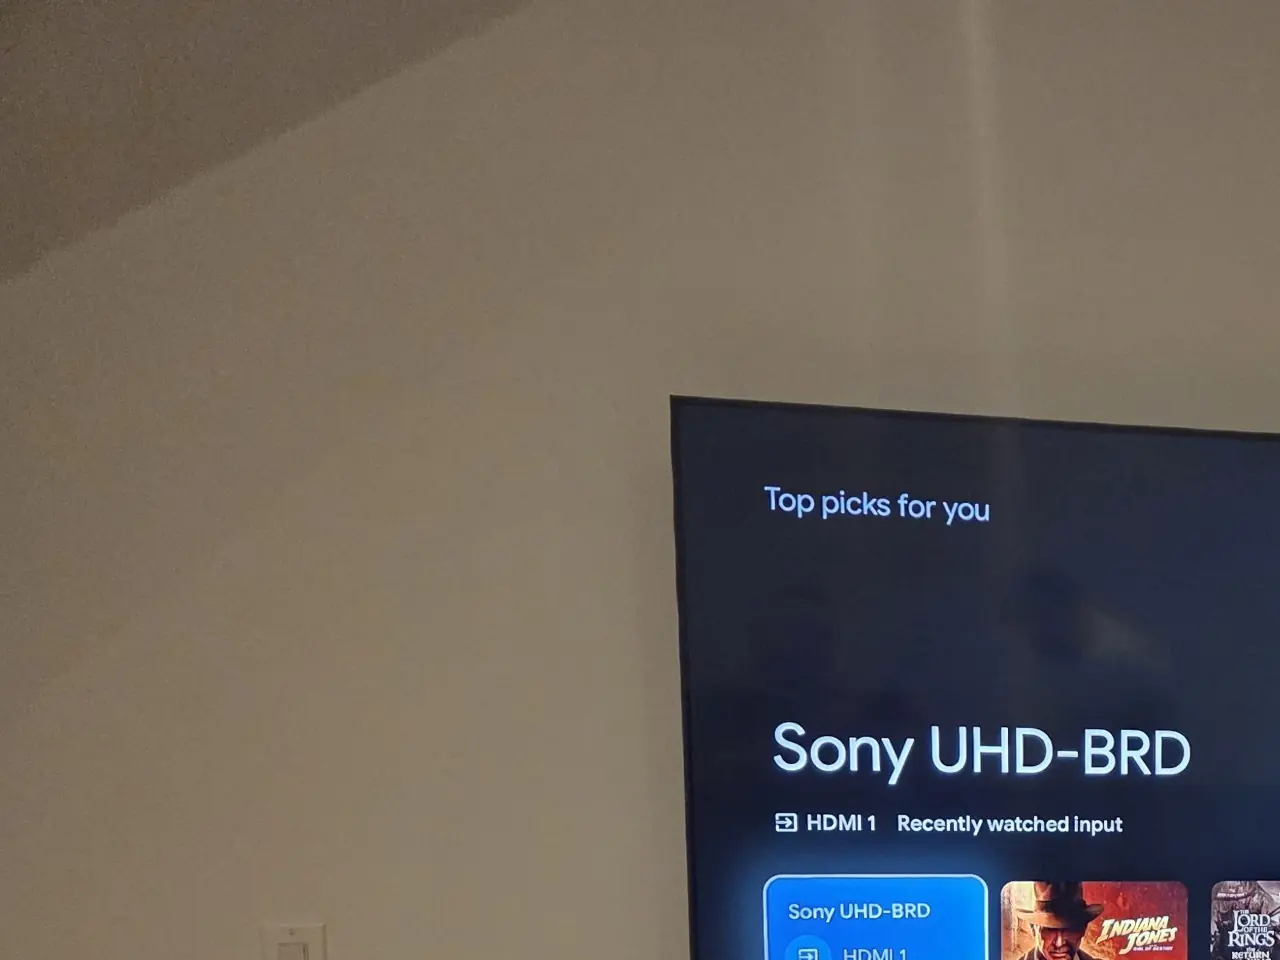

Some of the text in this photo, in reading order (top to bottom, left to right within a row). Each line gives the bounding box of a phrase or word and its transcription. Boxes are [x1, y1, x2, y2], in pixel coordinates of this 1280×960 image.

[763, 486, 990, 526] Top picks for you
[773, 721, 1191, 785] Sony UHD-BRD
[807, 813, 1123, 837] HDMI 1 Recently watched input
[788, 902, 931, 923] Sony UHD-BRD
[1233, 910, 1271, 932] LORD
[1096, 916, 1169, 944] INDIANA
[1119, 927, 1178, 955] JONES
[1228, 931, 1275, 947] RINGS
